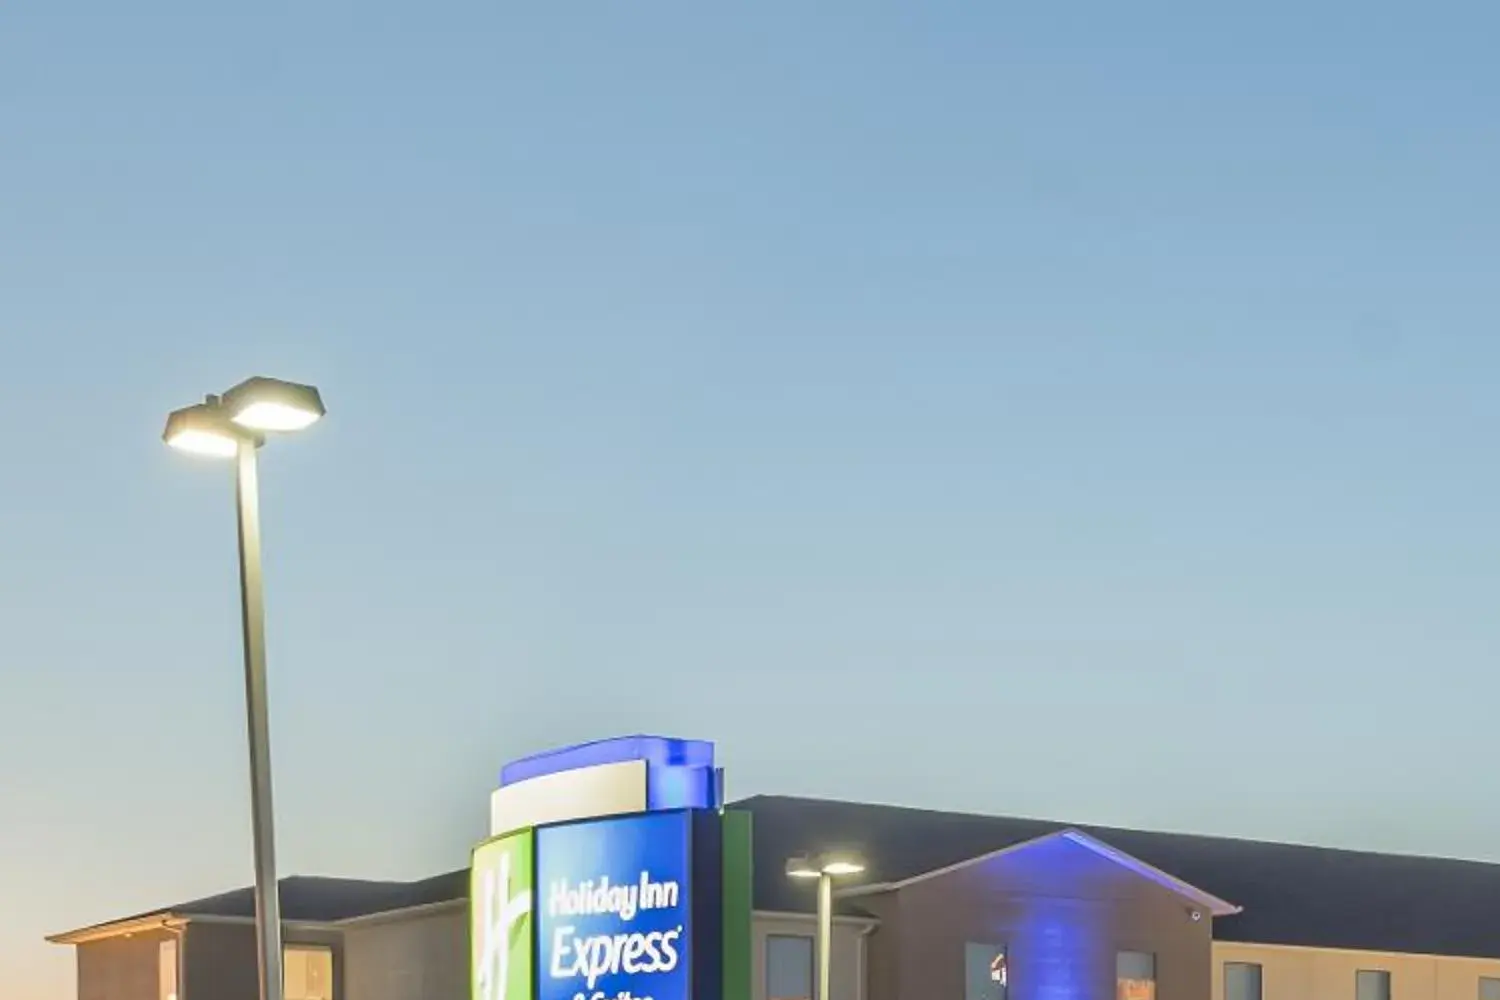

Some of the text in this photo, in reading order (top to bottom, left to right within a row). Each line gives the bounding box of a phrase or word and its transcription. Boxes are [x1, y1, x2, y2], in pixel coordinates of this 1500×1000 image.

[550, 870, 679, 921] Holiday Inn
[550, 925, 678, 989] Express
